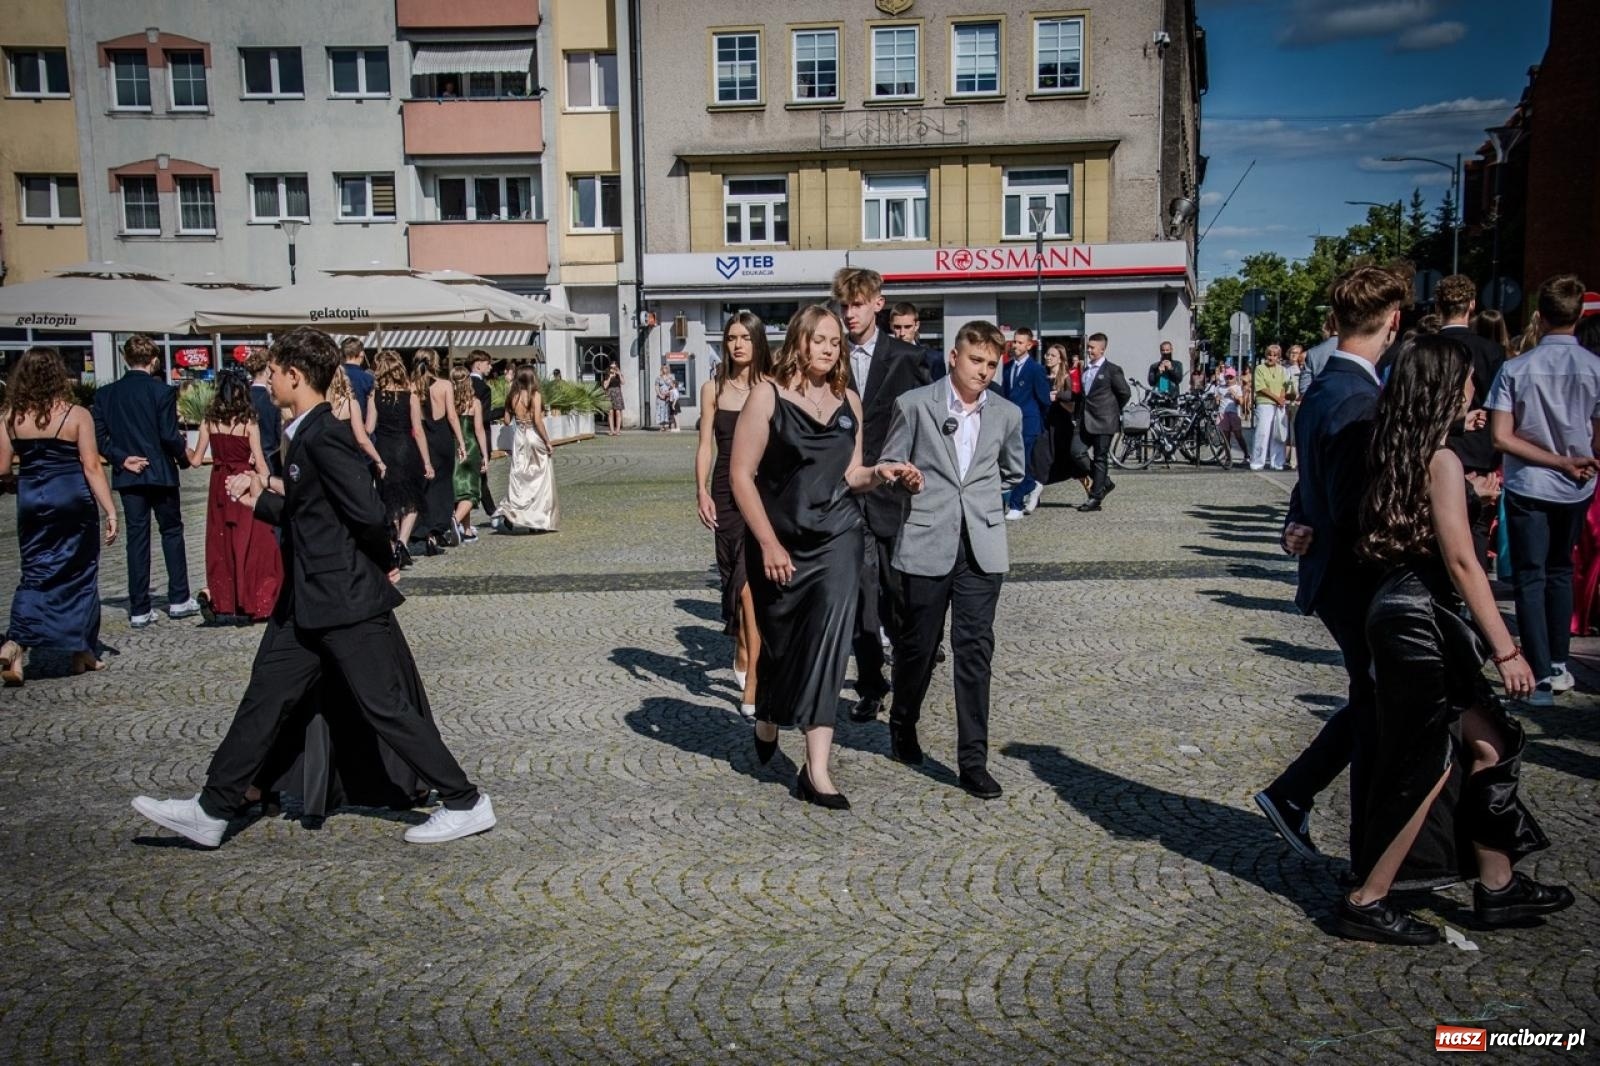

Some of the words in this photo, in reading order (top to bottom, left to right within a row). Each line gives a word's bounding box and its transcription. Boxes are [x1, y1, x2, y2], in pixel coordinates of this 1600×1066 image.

[742, 255, 774, 268] TEB
[935, 246, 1092, 271] ROSSMANN
[15, 313, 77, 327] gelatopiu
[308, 307, 369, 321] gelatopiu
